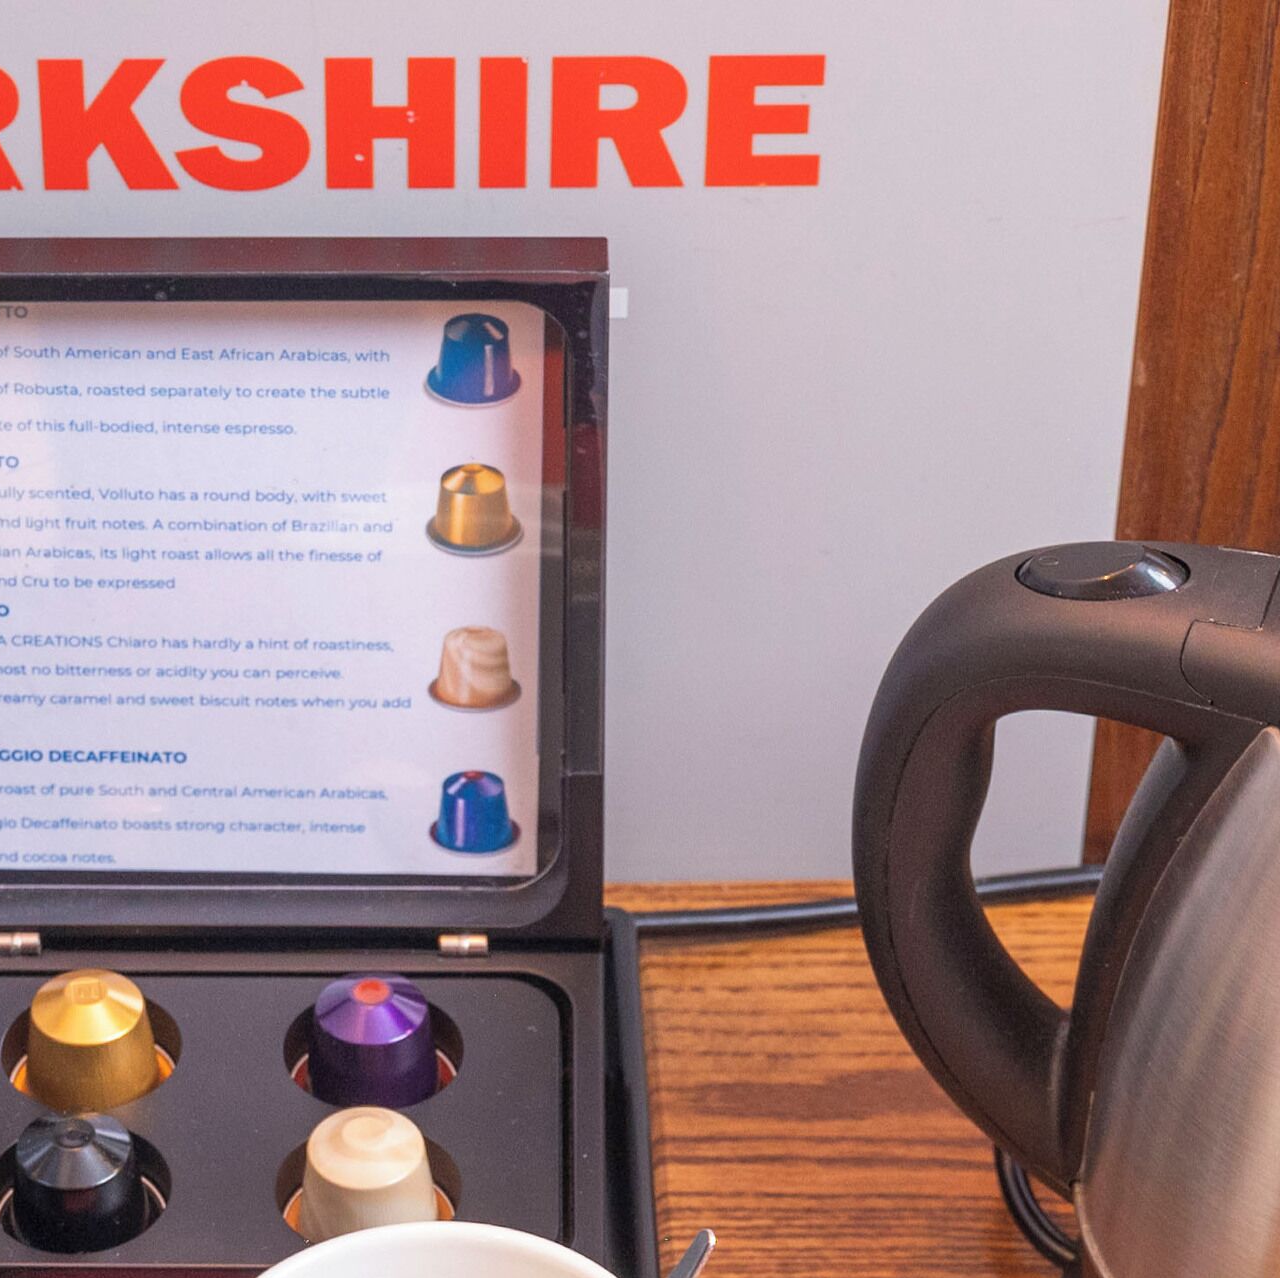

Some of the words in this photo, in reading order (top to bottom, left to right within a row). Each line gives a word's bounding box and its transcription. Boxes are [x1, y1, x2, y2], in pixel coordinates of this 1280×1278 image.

[13, 345, 61, 359] South
[64, 347, 142, 360] American
[146, 347, 177, 360] and
[180, 347, 214, 361] East
[219, 347, 275, 361] African
[279, 349, 351, 362] Arabicas,
[354, 349, 390, 363] with
[13, 382, 82, 396] Robusta,
[86, 384, 146, 397] roasted
[149, 385, 232, 401] separately
[235, 386, 253, 398] to
[255, 386, 306, 398] create
[310, 386, 337, 399] the
[340, 386, 391, 400] subtle
[16, 420, 36, 433] of
[36, 419, 66, 433] this
[162, 422, 221, 435] intense
[98, 487, 155, 501] Volluto
[158, 489, 186, 502] has
[189, 491, 199, 502] a
[203, 489, 251, 503] round
[301, 490, 337, 503] with
[340, 491, 387, 503] sweet
[25, 515, 60, 533] light
[64, 516, 97, 530] fruit
[152, 518, 164, 531] A
[167, 519, 268, 533] combination
[271, 518, 288, 532] of
[362, 520, 394, 534] and
[25, 546, 95, 560] Arabicas,
[99, 548, 118, 561] its
[121, 547, 157, 563] light
[161, 549, 199, 561] roast
[204, 548, 253, 561] allows
[256, 549, 274, 562] all
[277, 549, 305, 562] the
[308, 548, 363, 562] finesse
[367, 550, 383, 563] of
[21, 575, 50, 588] Cru
[52, 577, 70, 589] to
[73, 576, 94, 589] be
[96, 576, 176, 590] expressed
[10, 634, 103, 648] CREATIONS
[106, 635, 158, 649] Chiaro
[161, 637, 189, 650] has
[192, 637, 242, 653] hardly
[244, 639, 255, 650] a
[257, 639, 289, 650] hint
[293, 638, 310, 651] of
[312, 640, 394, 653] roastiness,
[31, 666, 52, 677] no
[54, 664, 133, 677] bitterness
[135, 667, 151, 678] or
[155, 665, 208, 680] acidity
[210, 668, 239, 681] you
[242, 668, 271, 679] can
[49, 693, 112, 706] caramel
[115, 694, 146, 707] and
[149, 695, 195, 707] sweet
[199, 695, 250, 708] biscuit
[254, 696, 299, 708] notes
[301, 696, 346, 709] when
[349, 698, 378, 711] you
[381, 697, 412, 710] add
[48, 750, 188, 764] DECAFFEINATO
